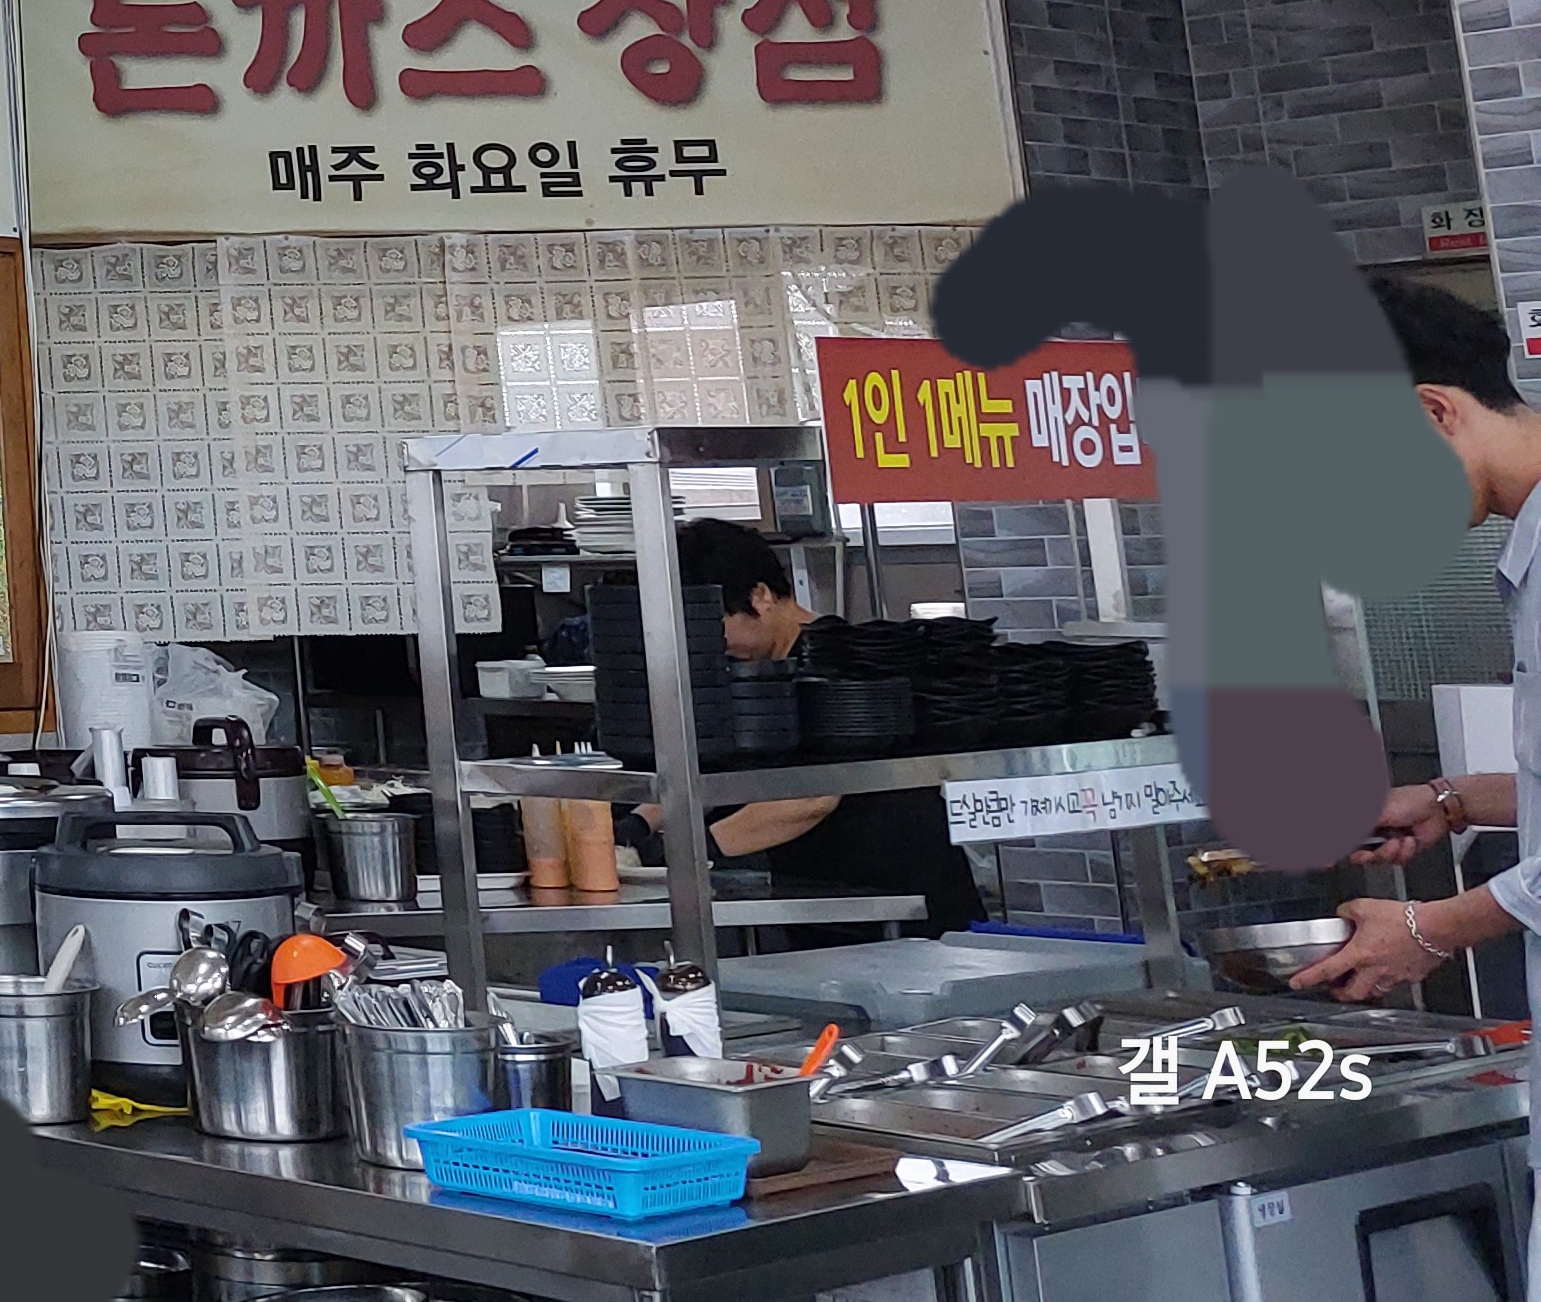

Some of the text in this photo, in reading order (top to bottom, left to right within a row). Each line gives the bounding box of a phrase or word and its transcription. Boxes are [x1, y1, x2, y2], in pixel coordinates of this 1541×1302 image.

[269, 137, 726, 201] 매주 화요일 휴무
[843, 369, 910, 467] 1인
[916, 371, 1020, 467] 1메뉴
